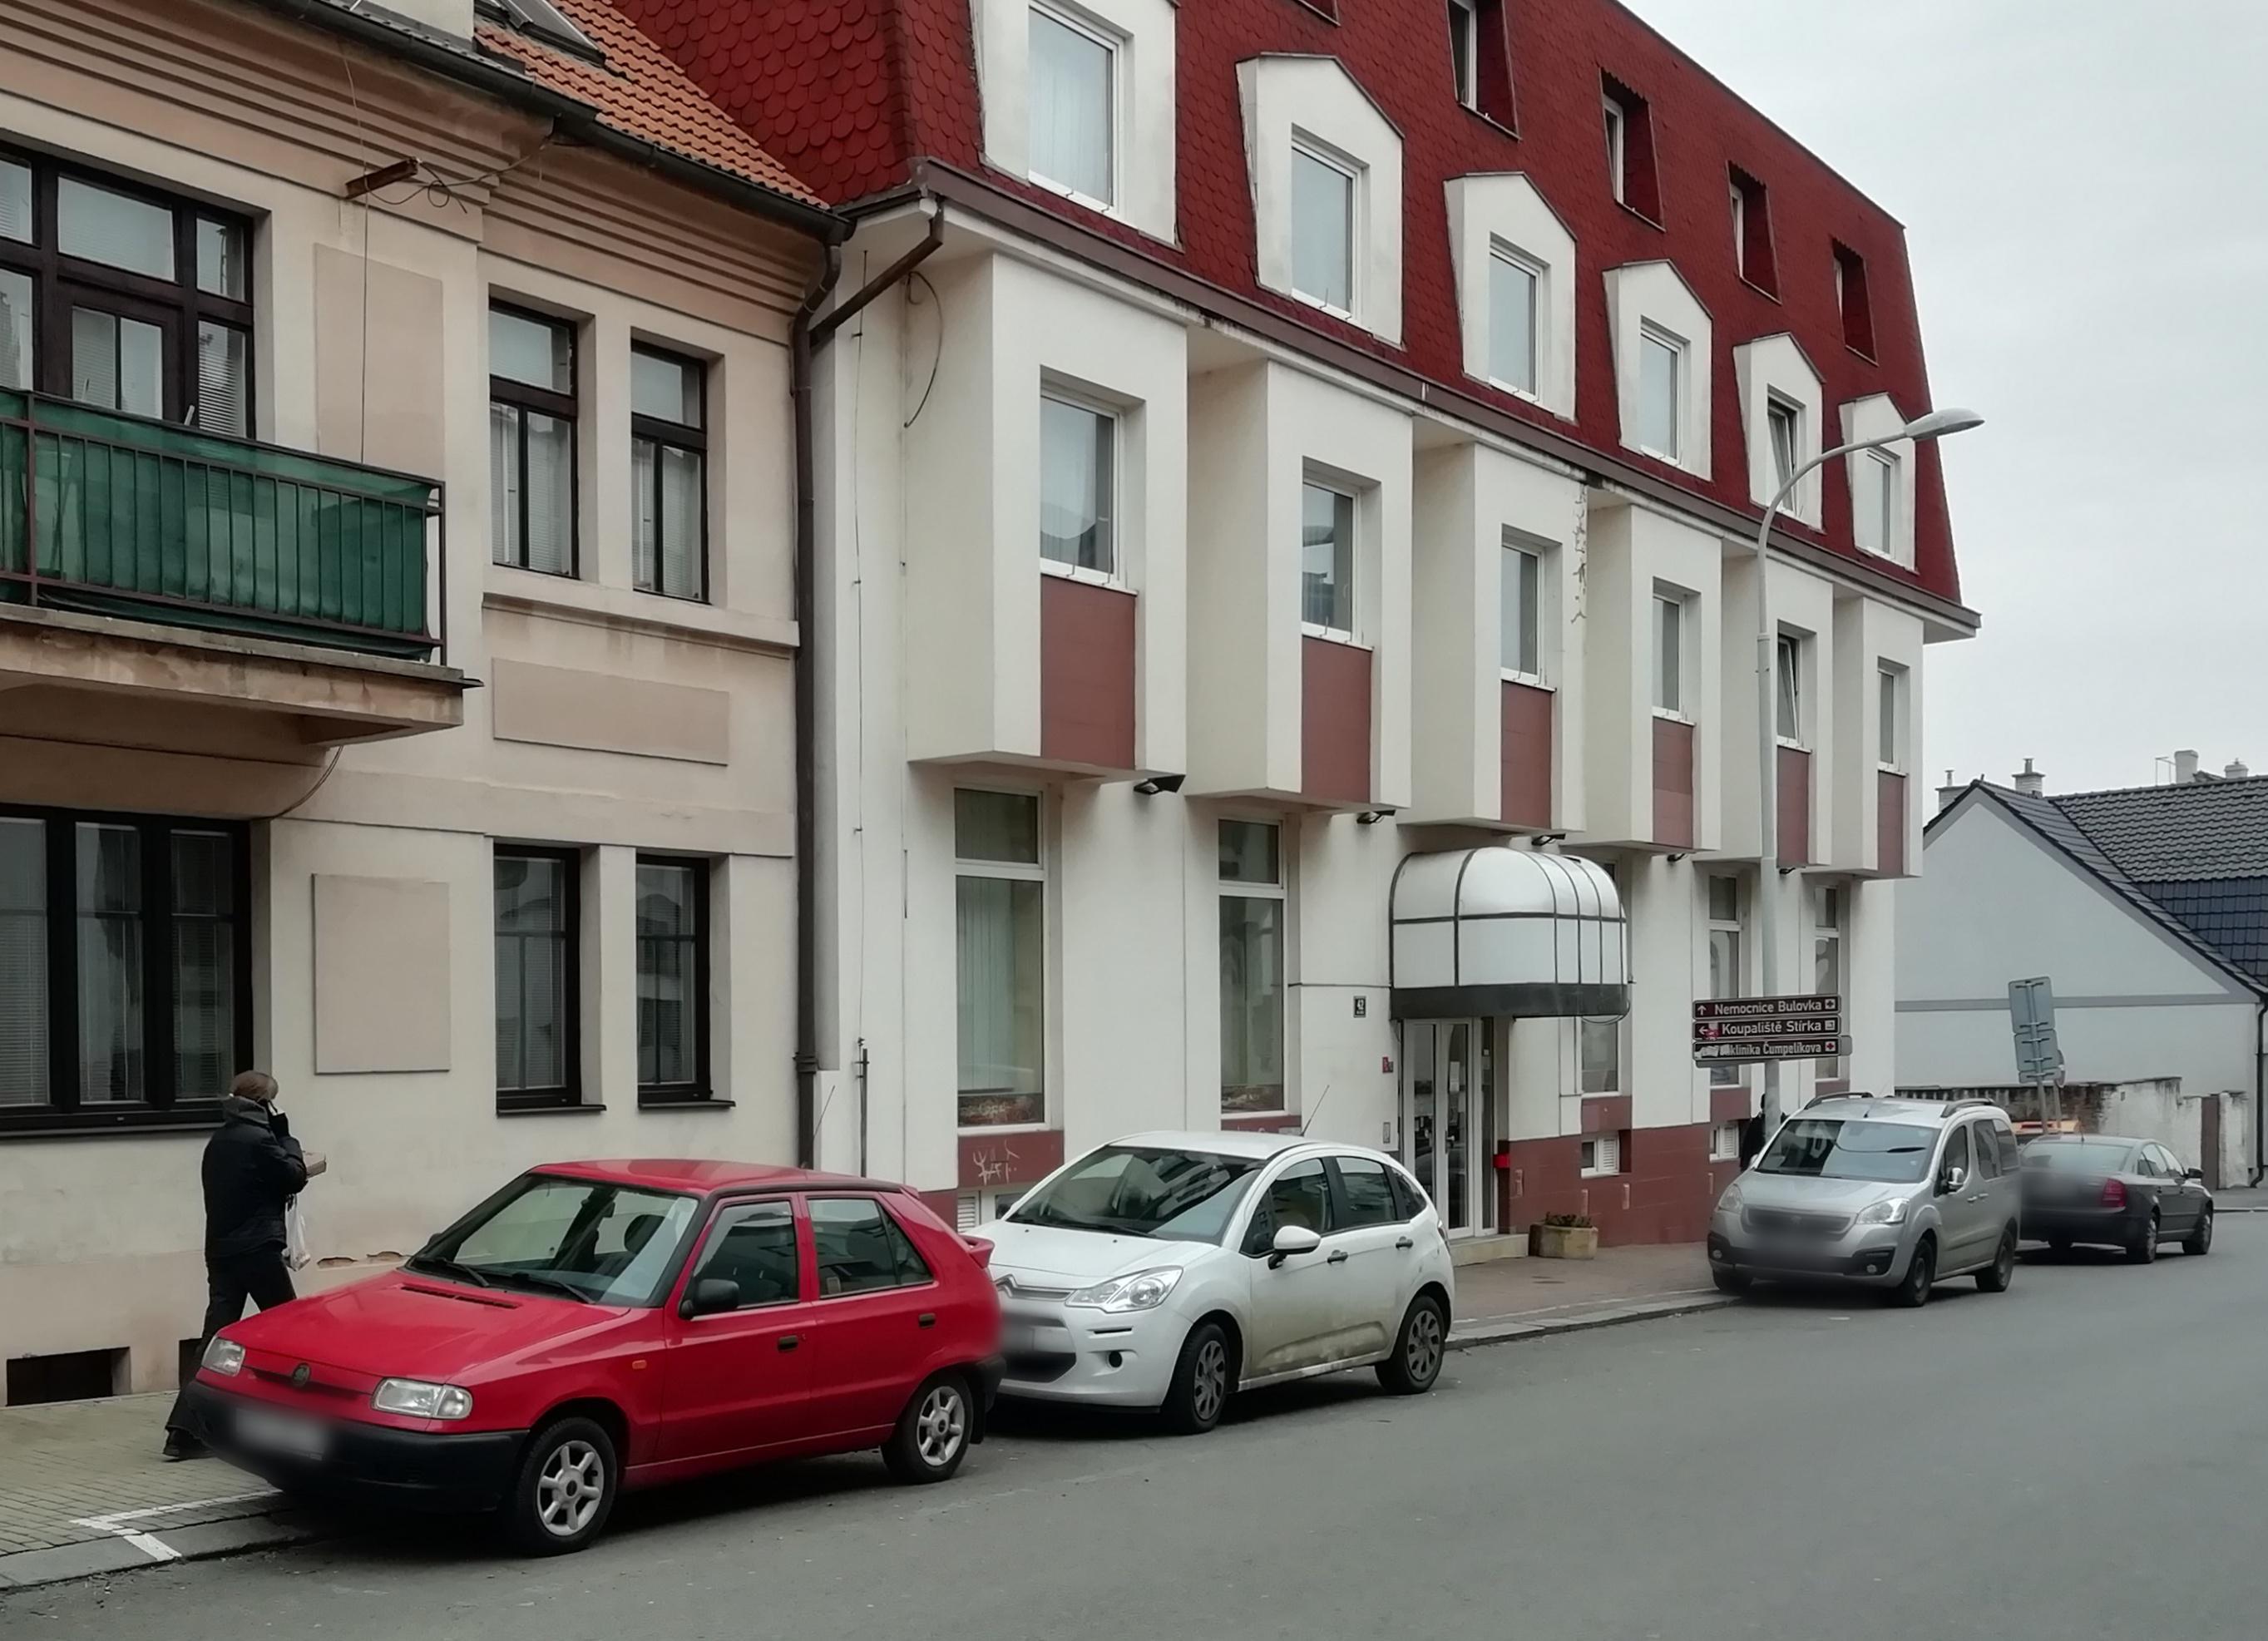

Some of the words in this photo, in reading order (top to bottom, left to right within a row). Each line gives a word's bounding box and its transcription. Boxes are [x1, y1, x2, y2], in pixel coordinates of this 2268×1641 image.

[1715, 1004, 1774, 1016] Nemocnice
[1778, 1000, 1821, 1012] Bulovka
[1722, 1021, 1782, 1036] Koupaliště
